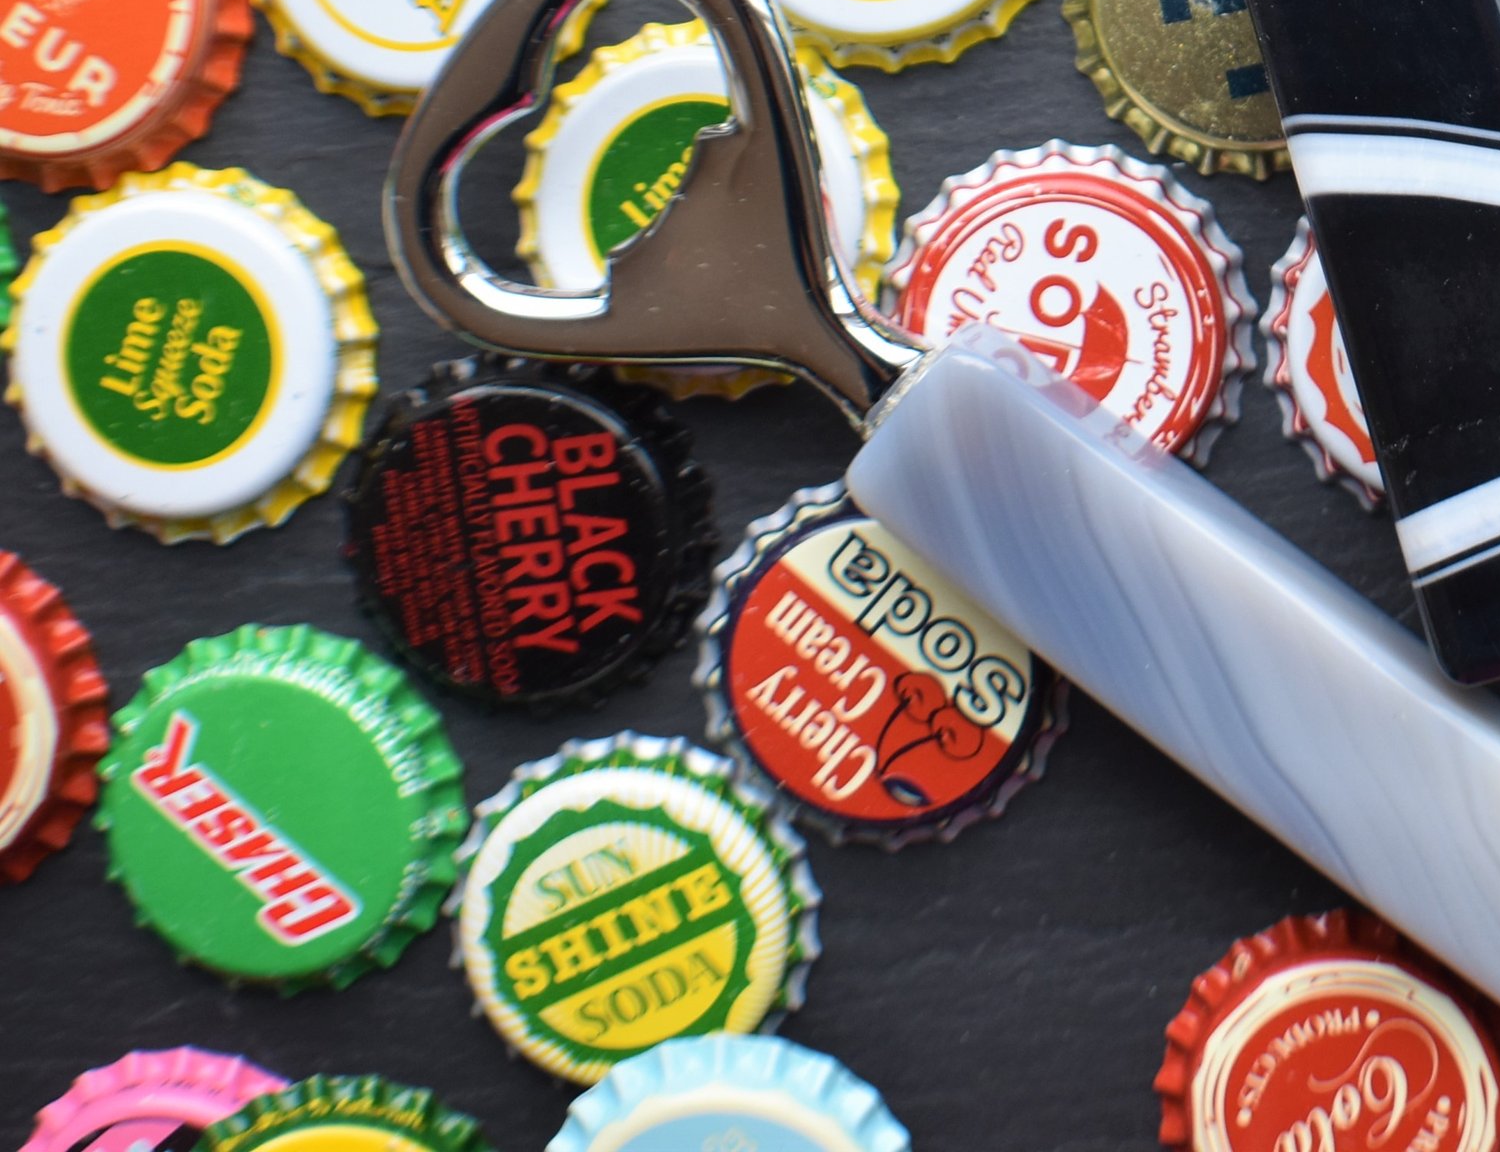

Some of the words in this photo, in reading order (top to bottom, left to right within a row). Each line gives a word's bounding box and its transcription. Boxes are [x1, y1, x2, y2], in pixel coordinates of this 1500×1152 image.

[619, 145, 694, 229] Lim
[966, 221, 1025, 293] Red
[100, 297, 163, 396] Lime
[133, 298, 201, 422] Squeeze
[175, 325, 244, 425] Soda
[485, 423, 580, 654] CHERRY
[553, 431, 643, 634] BLACK
[764, 591, 888, 723] Cream
[826, 530, 1027, 727] Soda
[746, 664, 878, 802] Cherry
[505, 861, 733, 1000] SHINE
[535, 837, 637, 912] SUN
[575, 948, 724, 1042] SODA
